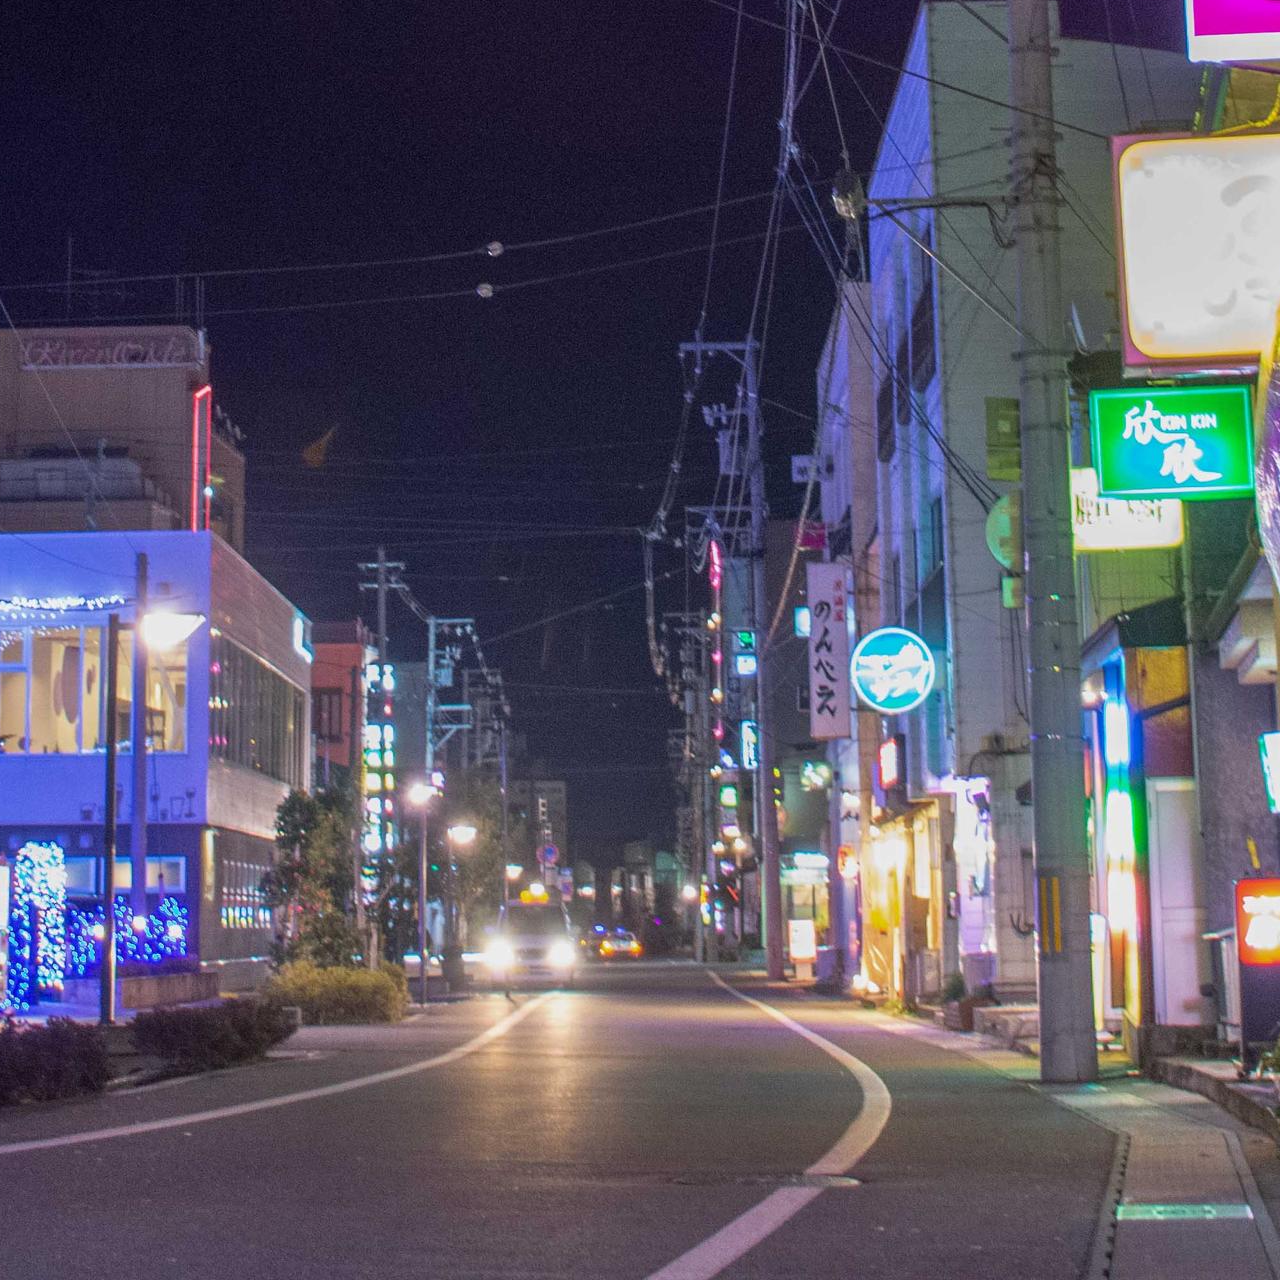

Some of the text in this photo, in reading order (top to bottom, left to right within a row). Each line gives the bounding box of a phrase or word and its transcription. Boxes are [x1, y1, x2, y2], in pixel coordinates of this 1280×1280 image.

[1191, 413, 1217, 429] KIN
[813, 599, 838, 718] のんべえ
